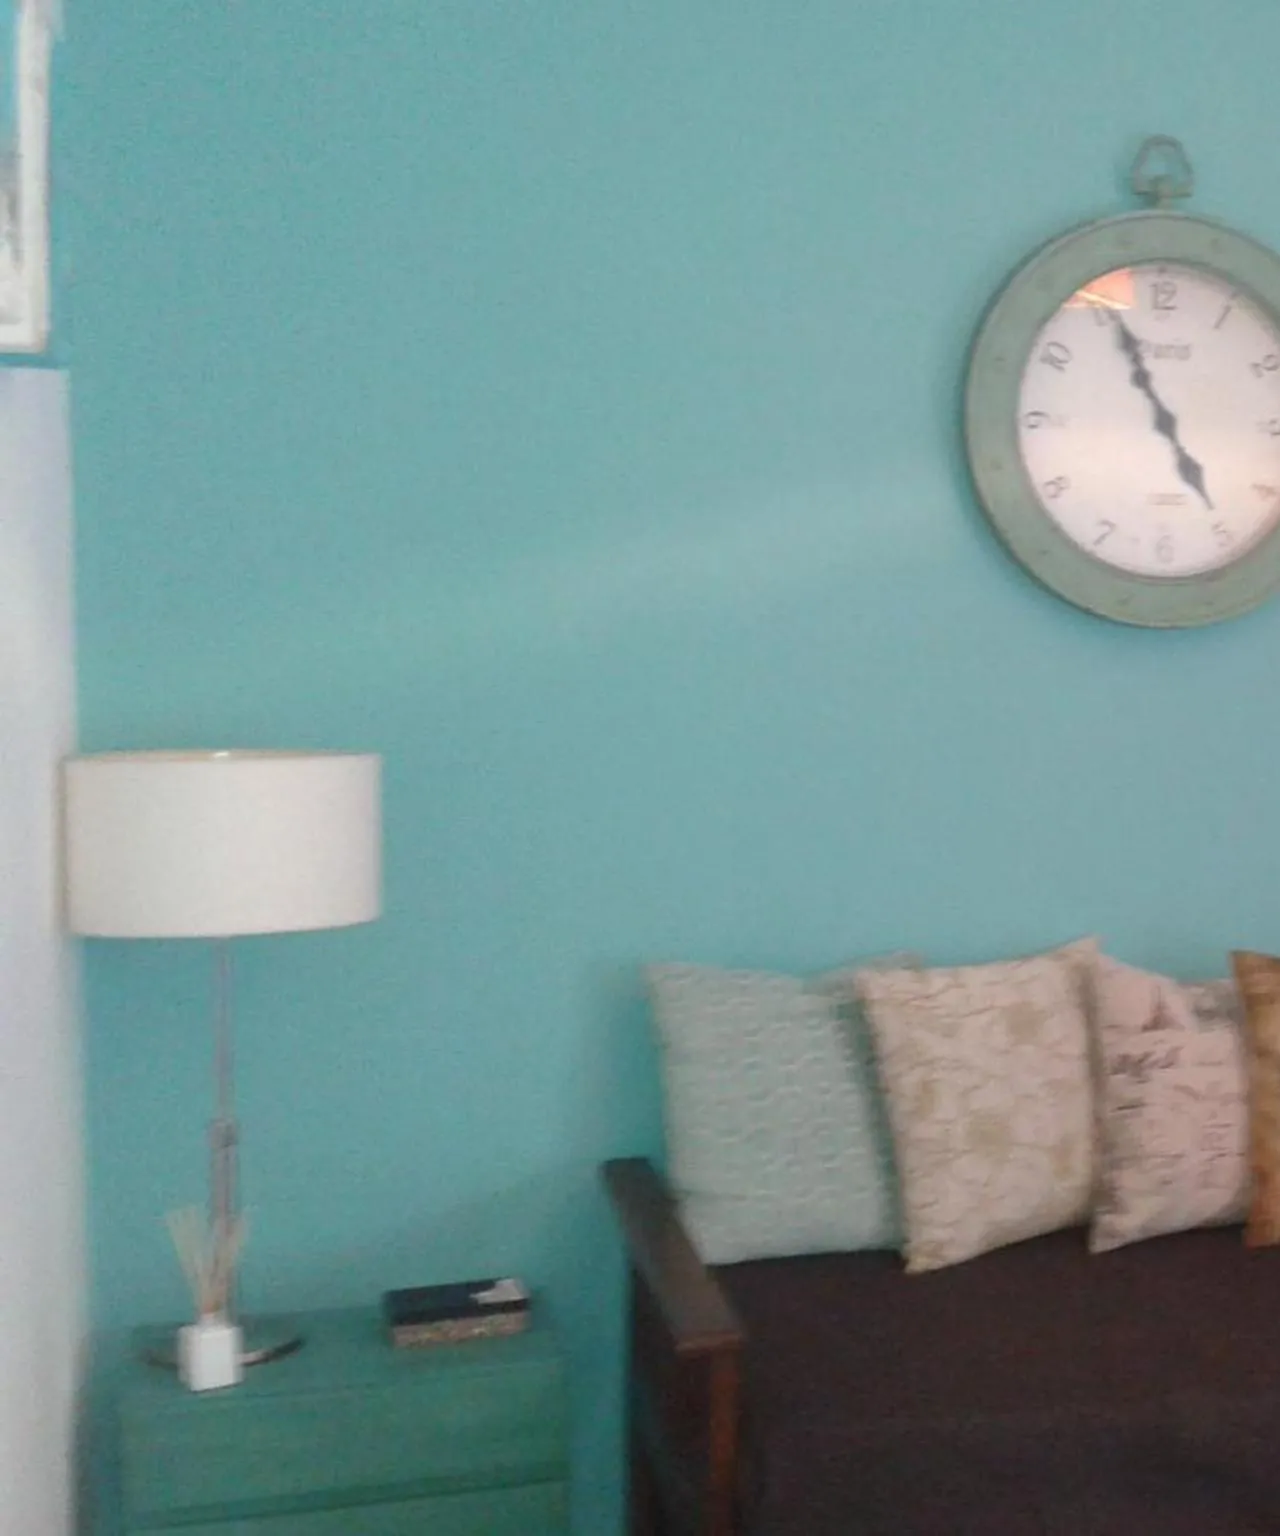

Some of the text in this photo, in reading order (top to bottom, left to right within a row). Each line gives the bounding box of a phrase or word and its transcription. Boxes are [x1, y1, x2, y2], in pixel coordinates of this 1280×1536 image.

[1148, 281, 1179, 310] 12
[1212, 303, 1233, 330] 1
[1038, 340, 1073, 373] 10
[1092, 518, 1118, 548] 7
[1154, 534, 1176, 565] 6
